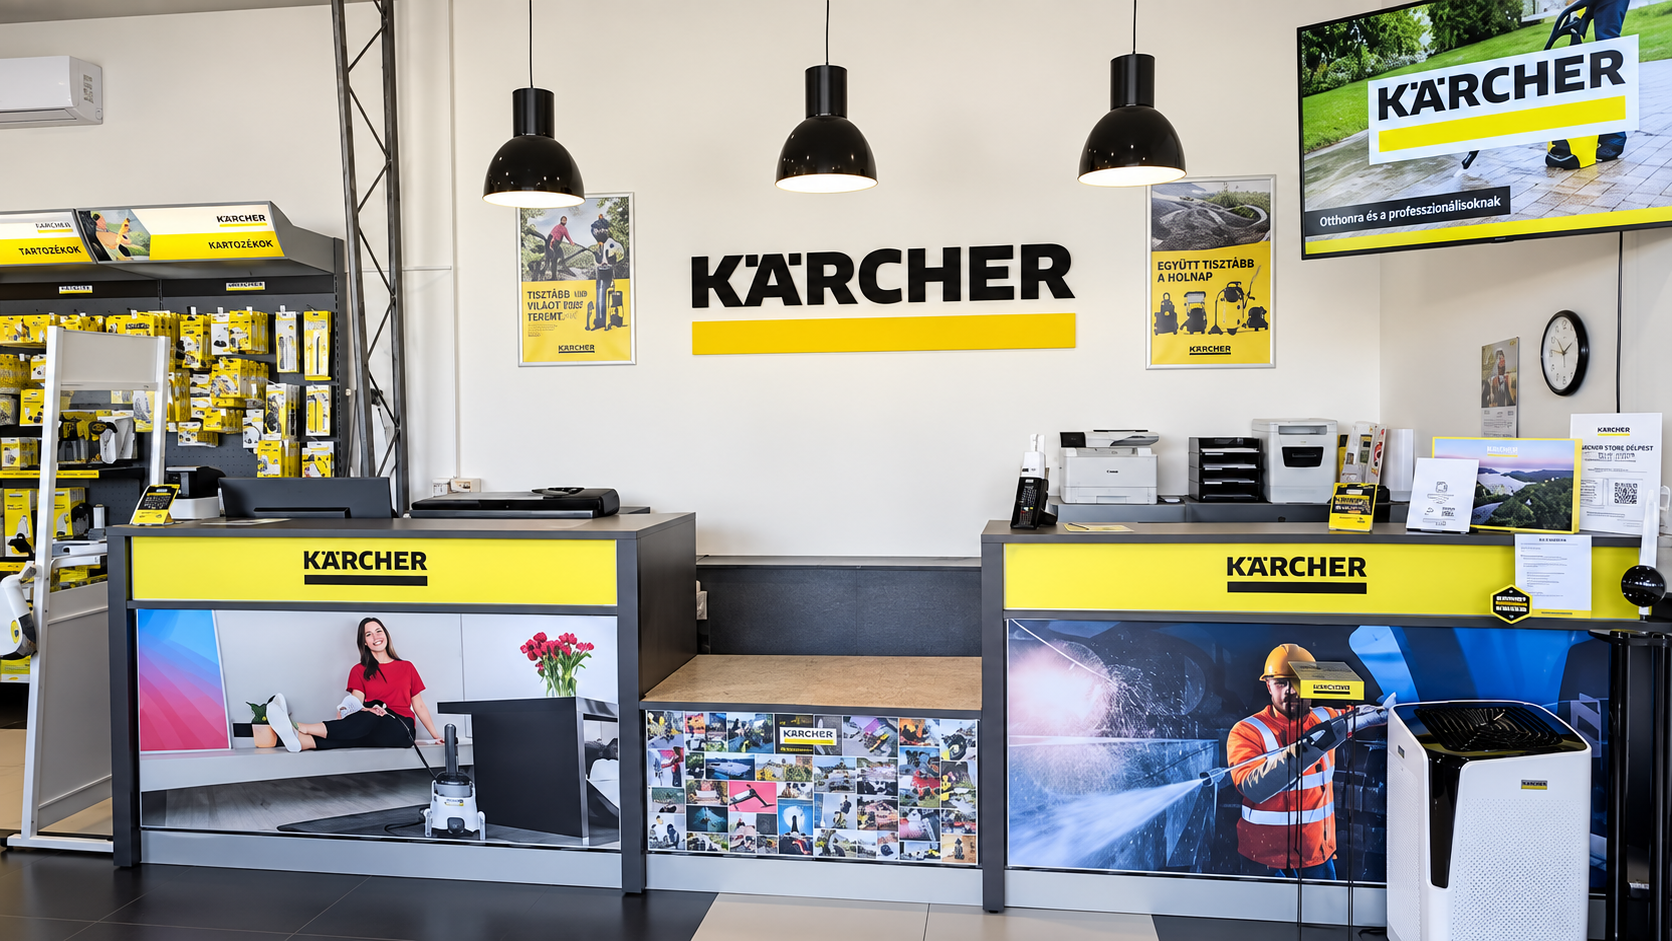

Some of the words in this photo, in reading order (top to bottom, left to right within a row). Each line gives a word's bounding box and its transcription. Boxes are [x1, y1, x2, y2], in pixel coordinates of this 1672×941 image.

[1378, 50, 1626, 121] KÄRCHER
[1319, 212, 1365, 227] Otthonra
[1366, 210, 1379, 222] és
[1379, 211, 1386, 220] a
[1388, 195, 1501, 222] professzionálisoknak
[18, 244, 82, 256] TARTOZÉKOK
[208, 238, 274, 249] KARTOZÉKOK
[1157, 258, 1200, 271] EGYÜTT
[1202, 256, 1255, 270] TISZTÁBB
[691, 243, 1076, 309] KÄRCHER
[1157, 273, 1165, 283] A
[1167, 271, 1213, 282] HOLNAP
[527, 288, 571, 299] TISZTÁBB
[303, 550, 428, 571] KÄRCHER
[1227, 556, 1367, 578] KÄRCHER
